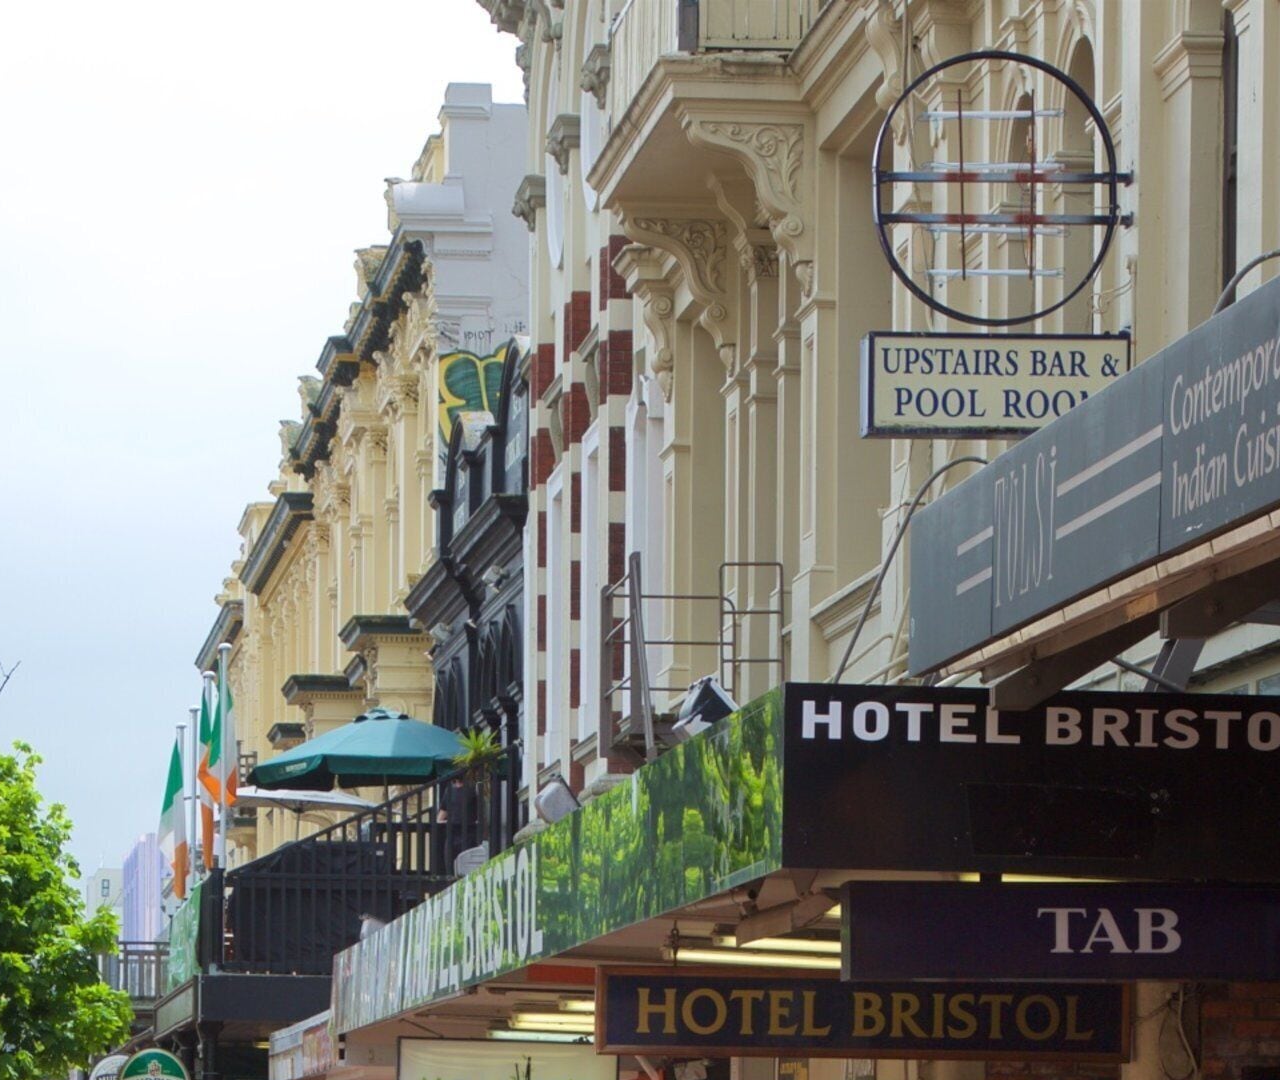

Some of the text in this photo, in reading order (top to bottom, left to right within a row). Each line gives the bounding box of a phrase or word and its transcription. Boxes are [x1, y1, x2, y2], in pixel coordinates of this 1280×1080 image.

[881, 347, 1120, 378] UPSTAIRS BAR &
[894, 387, 1089, 418] POOL ROO
[1172, 442, 1227, 519] Indian
[802, 700, 1020, 744] HOTEL
[462, 843, 544, 981] BRISTOL
[1037, 908, 1182, 954] TAB
[636, 987, 1094, 1041] HOTEL BRISTOL
